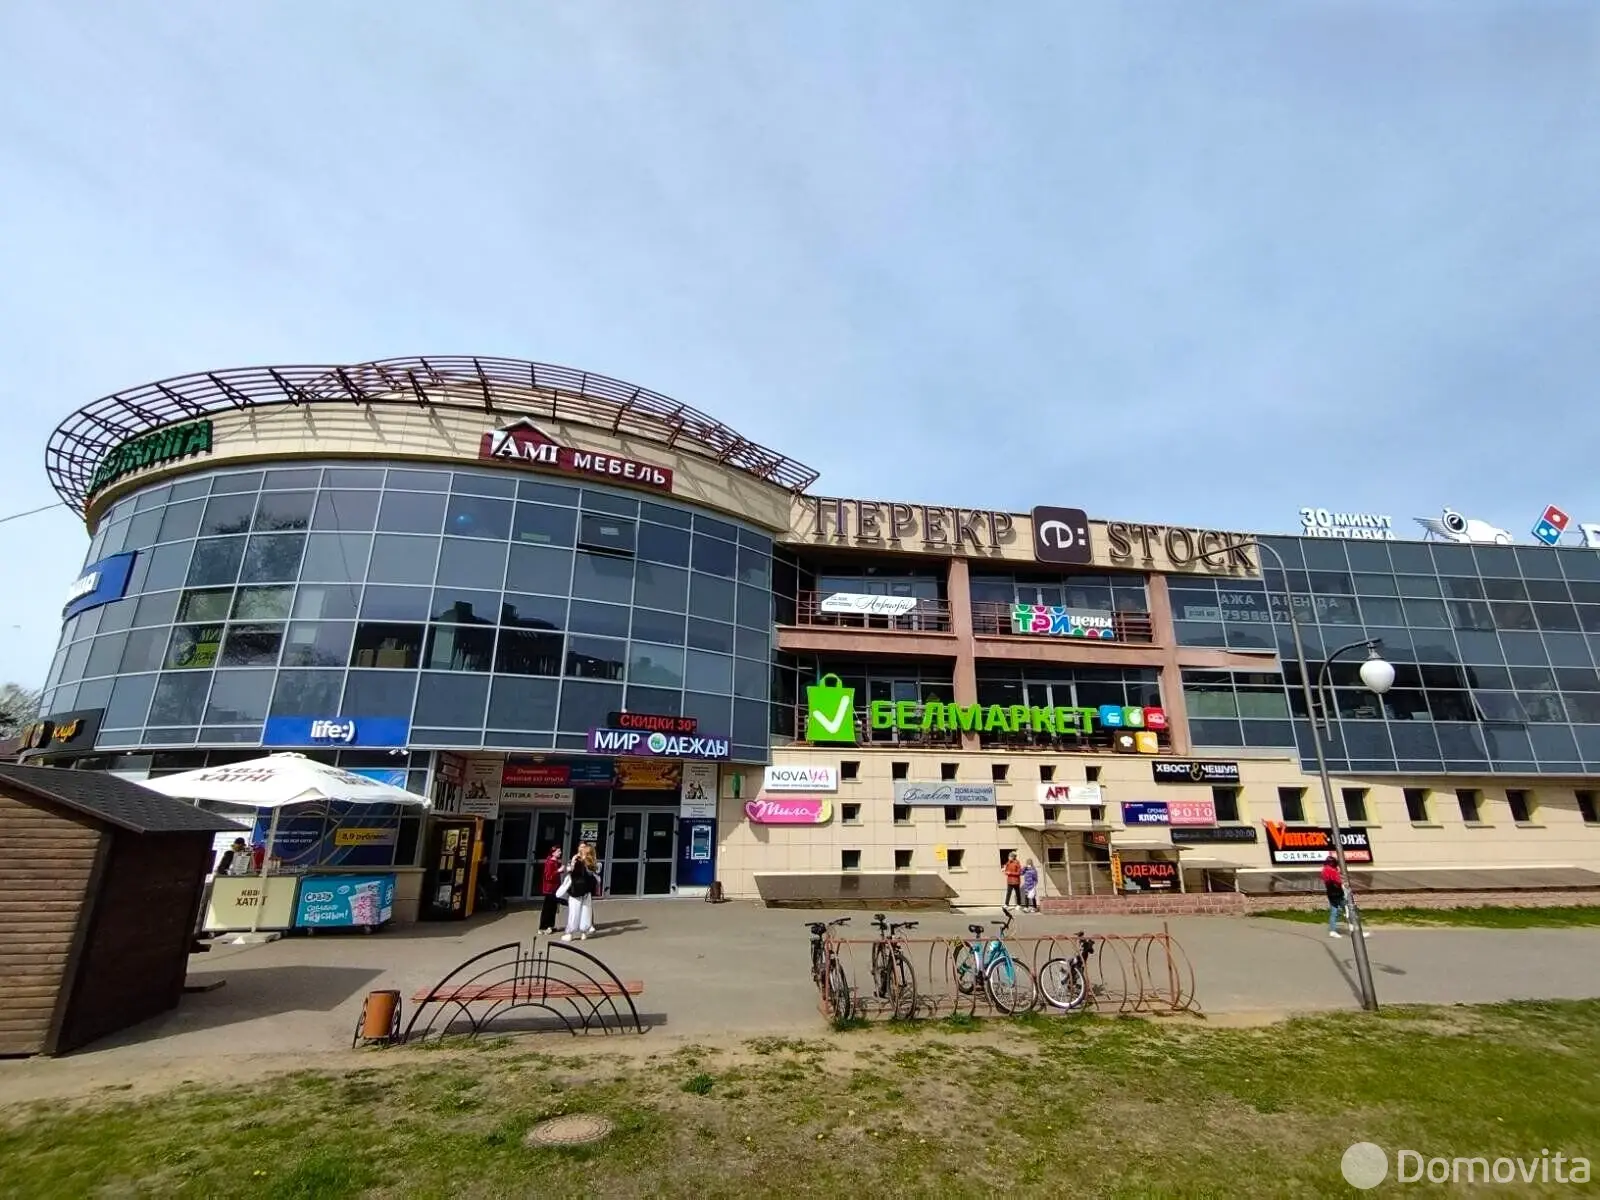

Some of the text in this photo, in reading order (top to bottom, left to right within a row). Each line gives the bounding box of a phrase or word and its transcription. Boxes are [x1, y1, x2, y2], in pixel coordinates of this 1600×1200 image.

[573, 452, 666, 484] МЕБЕЛЬ
[810, 498, 1014, 550] ПЕРЕКР
[1300, 507, 1391, 528] 30 МИНУТ
[1107, 520, 1258, 571] STOCK
[1070, 615, 1112, 629] цены
[620, 714, 674, 731] СКИДКИ
[870, 700, 1099, 736] БЕЛМАРКЕТ
[310, 719, 356, 742] life:)
[594, 731, 729, 758] МИР ОДЕЖДЫ
[1156, 764, 1191, 773] ХВОСТ
[1201, 765, 1238, 774] ЧЕШУЯ
[1138, 814, 1168, 822] КЛЮЧИ
[1170, 807, 1213, 817] ФОТО
[1124, 864, 1175, 877] ОДЕЖДА
